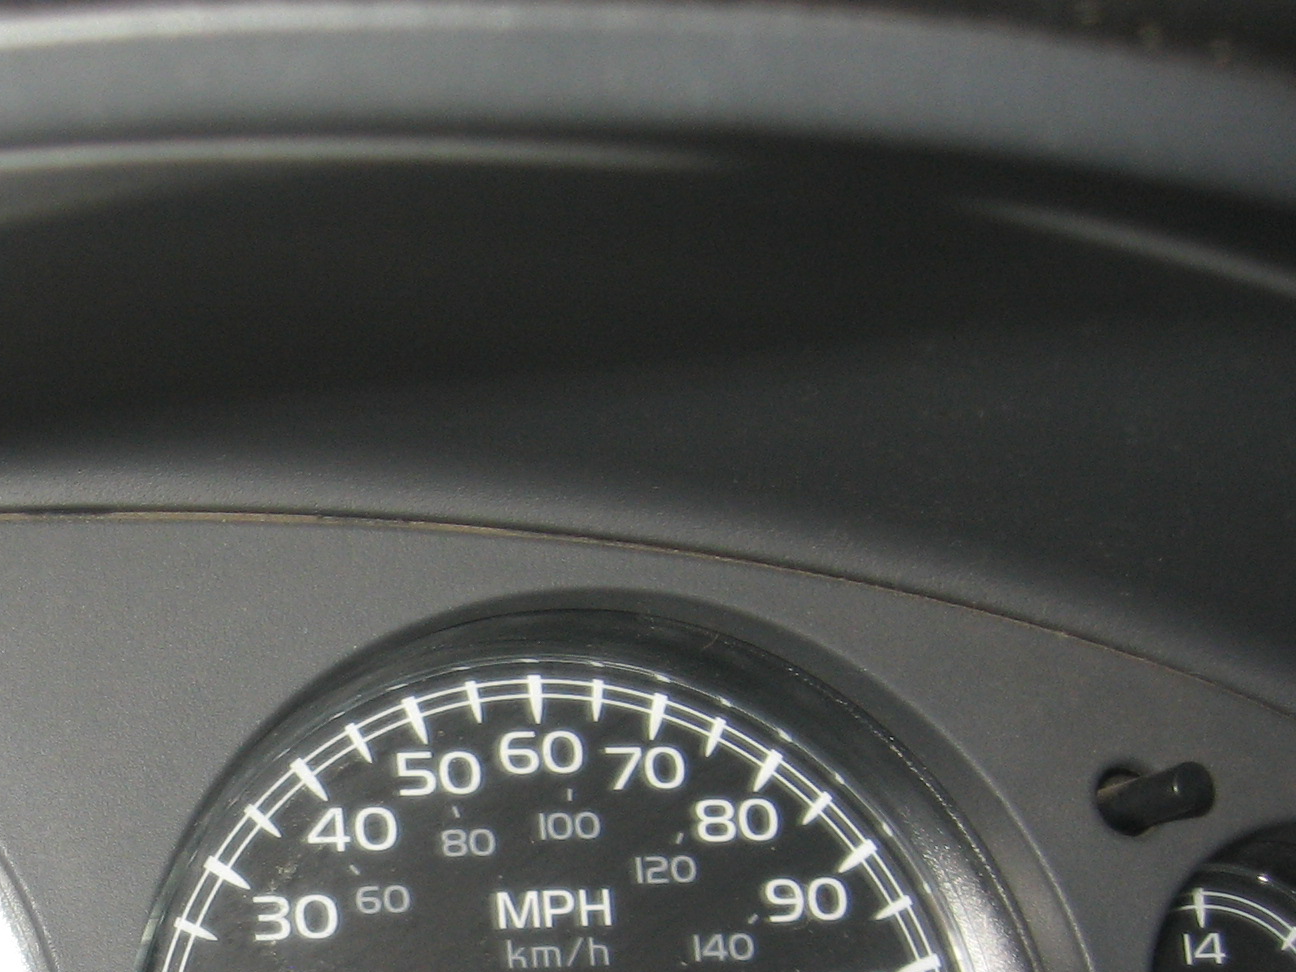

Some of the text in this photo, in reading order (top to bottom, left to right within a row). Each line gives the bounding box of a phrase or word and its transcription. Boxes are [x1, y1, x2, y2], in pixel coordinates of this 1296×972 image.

[395, 751, 483, 797] 50
[499, 730, 584, 776] 60
[606, 746, 686, 791] 70
[307, 807, 400, 853] 40
[539, 811, 601, 840] 100
[695, 799, 780, 843] 80
[441, 828, 496, 858] 80
[634, 854, 697, 885] 120
[252, 895, 340, 943] 30
[355, 884, 411, 915] 60
[495, 888, 613, 930] MPH
[763, 877, 849, 923] 90
[506, 937, 612, 969] km/h
[691, 932, 755, 963] 140
[1182, 931, 1226, 966] 14
